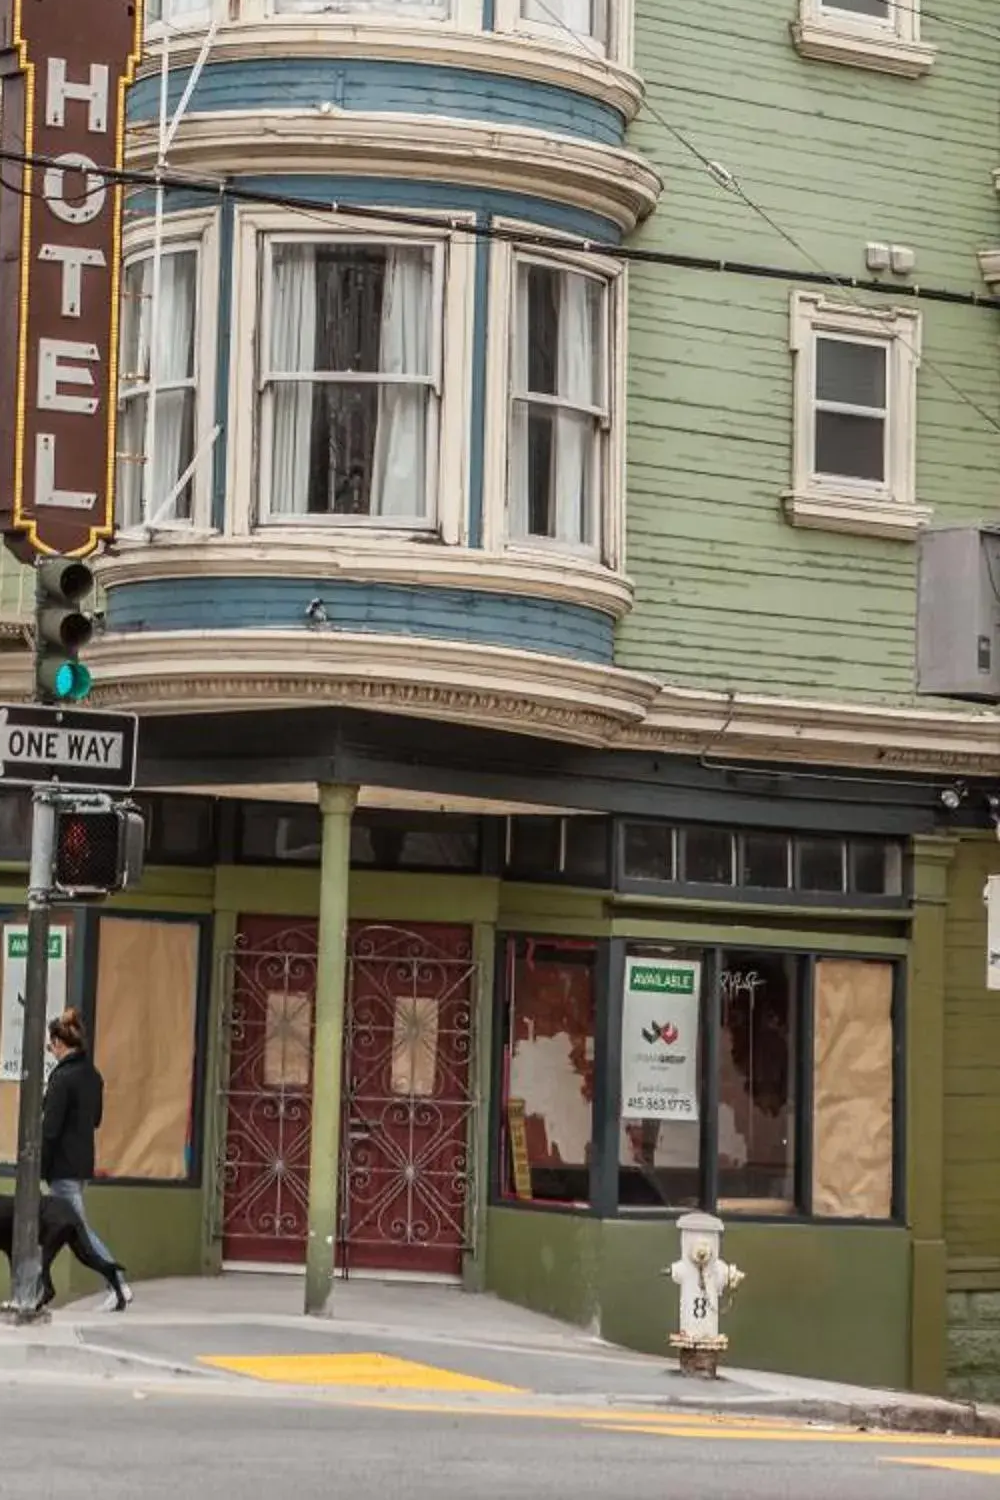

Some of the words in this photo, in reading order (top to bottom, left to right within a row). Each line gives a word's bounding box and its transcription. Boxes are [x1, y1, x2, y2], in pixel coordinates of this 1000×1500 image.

[34, 56, 109, 509] HOTEL
[8, 730, 59, 759] ONE
[66, 733, 116, 763] WAY
[632, 971, 693, 989] AVAILABLE
[693, 1297, 707, 1319] 8
